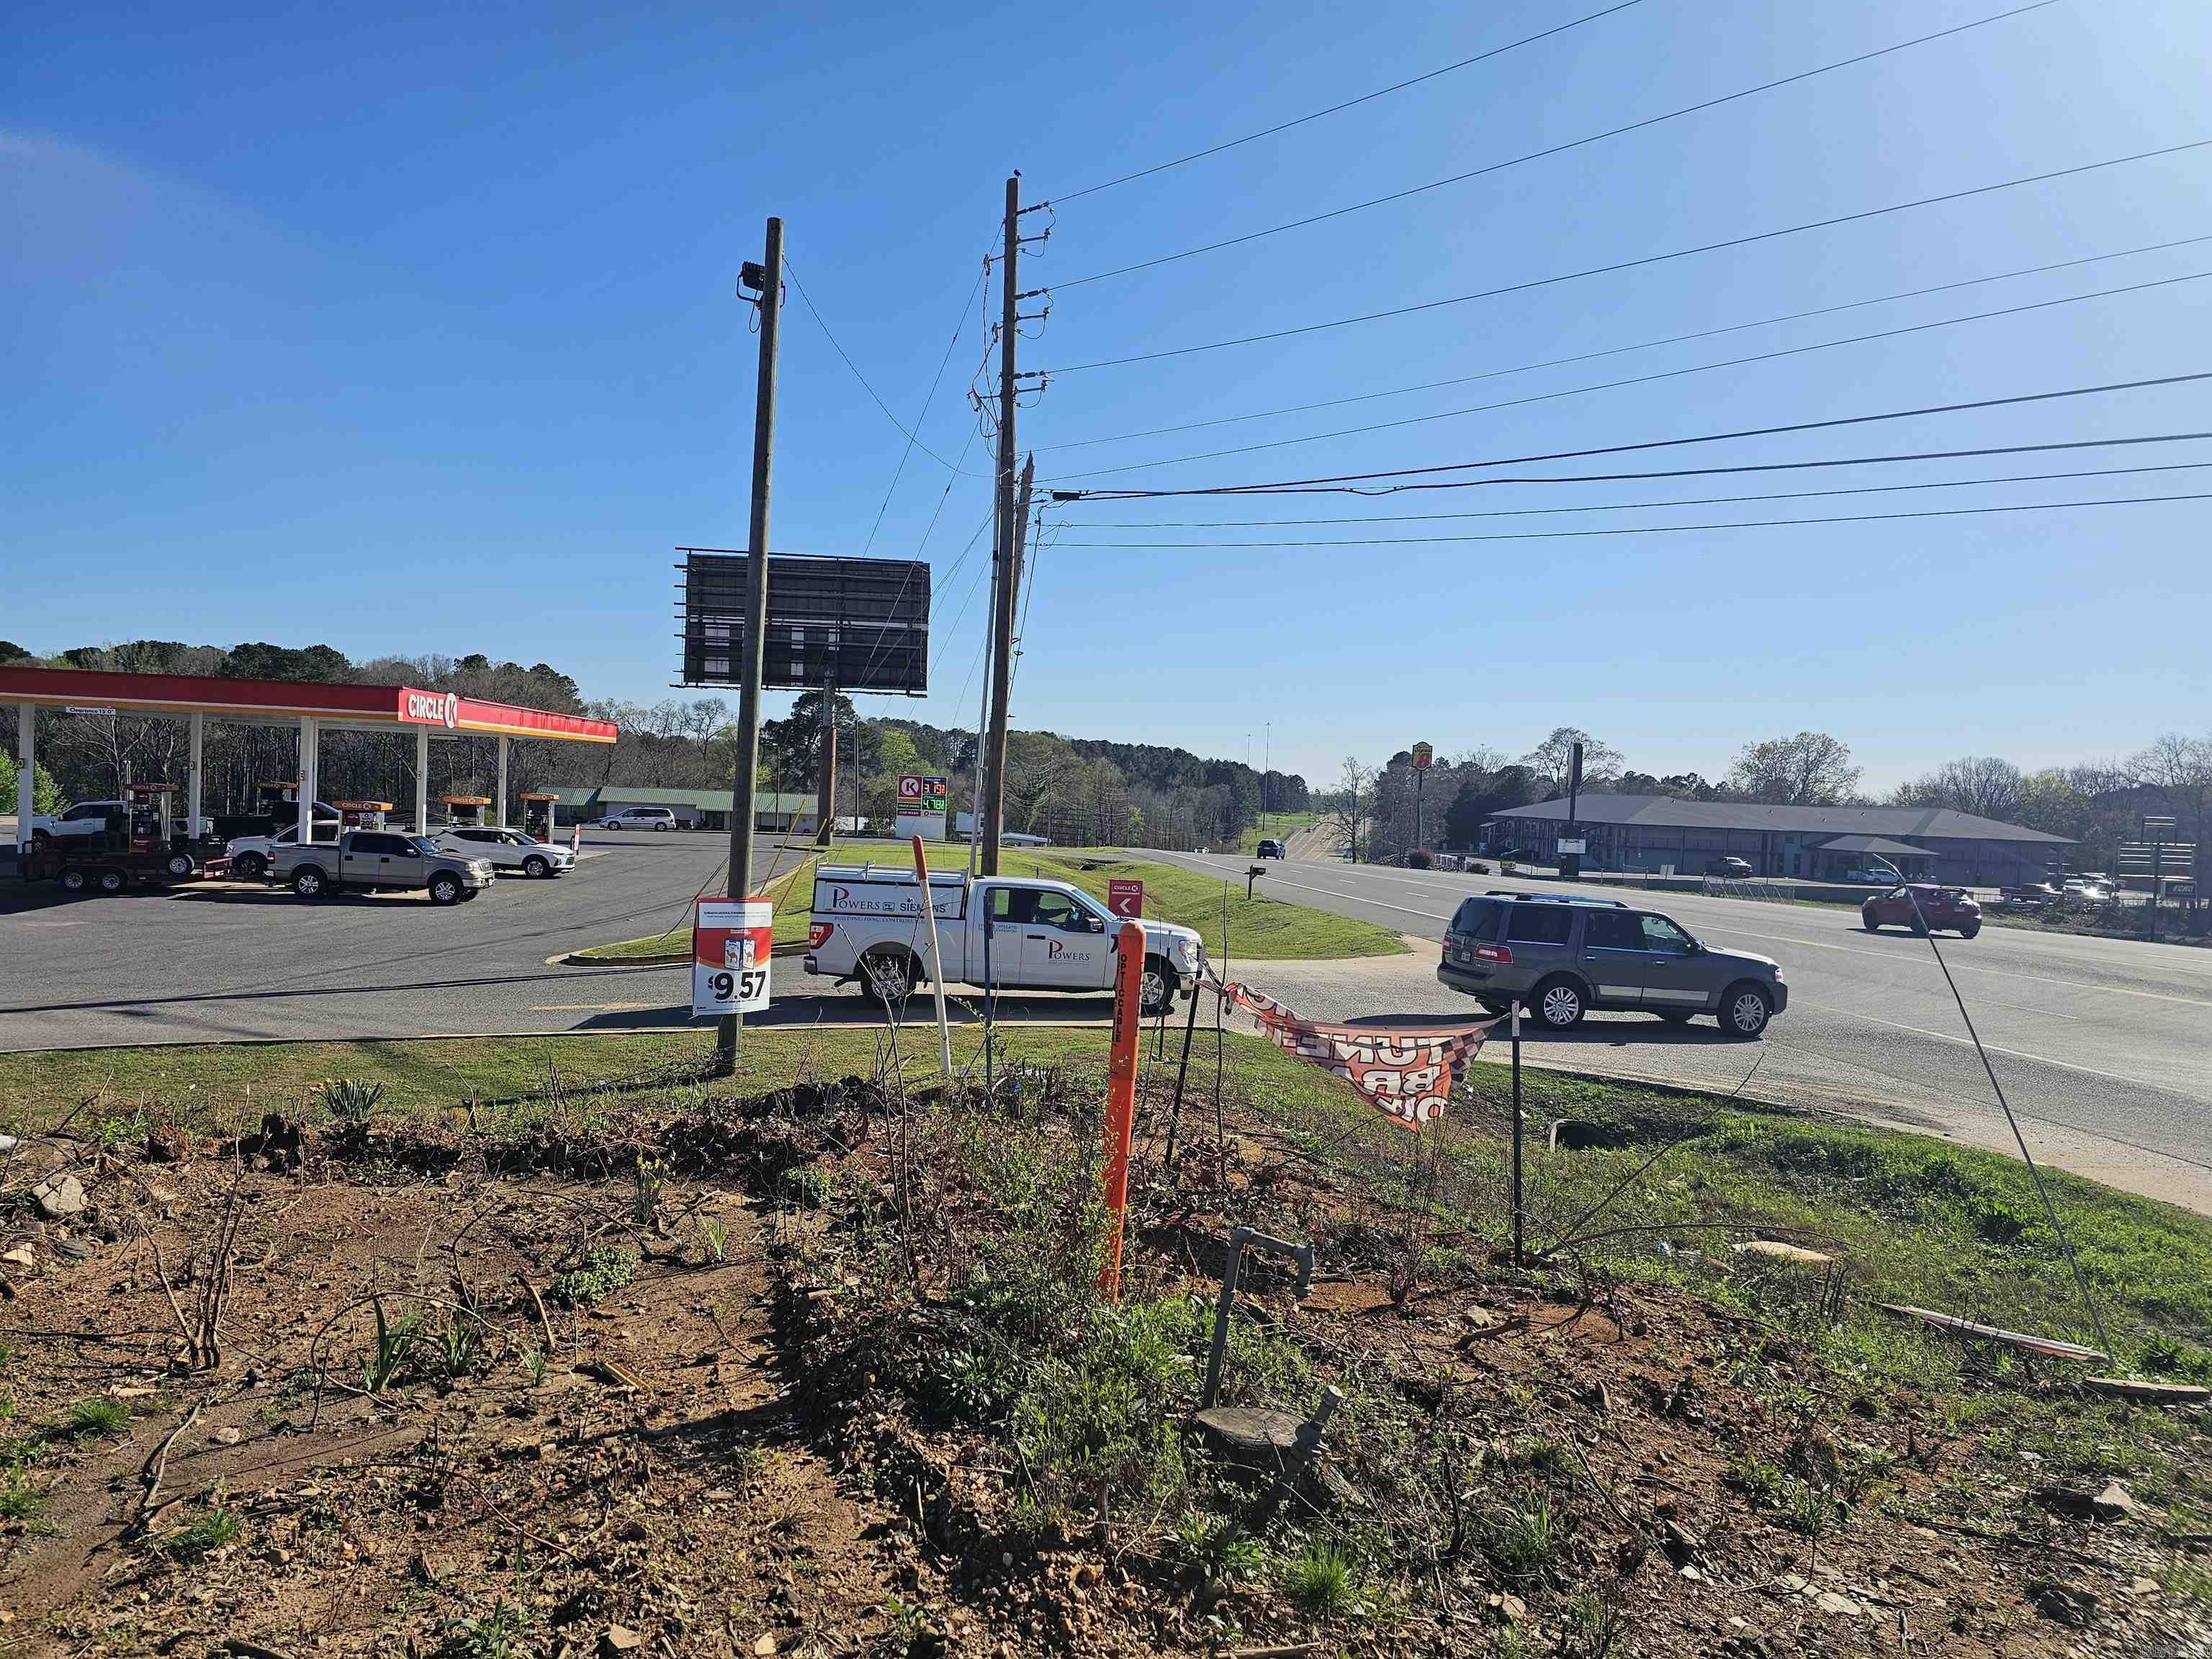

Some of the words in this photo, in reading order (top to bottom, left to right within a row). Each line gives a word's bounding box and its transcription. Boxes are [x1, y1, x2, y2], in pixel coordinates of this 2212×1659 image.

[408, 694, 444, 720] CIRCLE
[905, 781, 918, 795] K
[831, 886, 880, 910] POWERS
[899, 902, 946, 913] SIEMNS
[1048, 939, 1089, 961] POWERS
